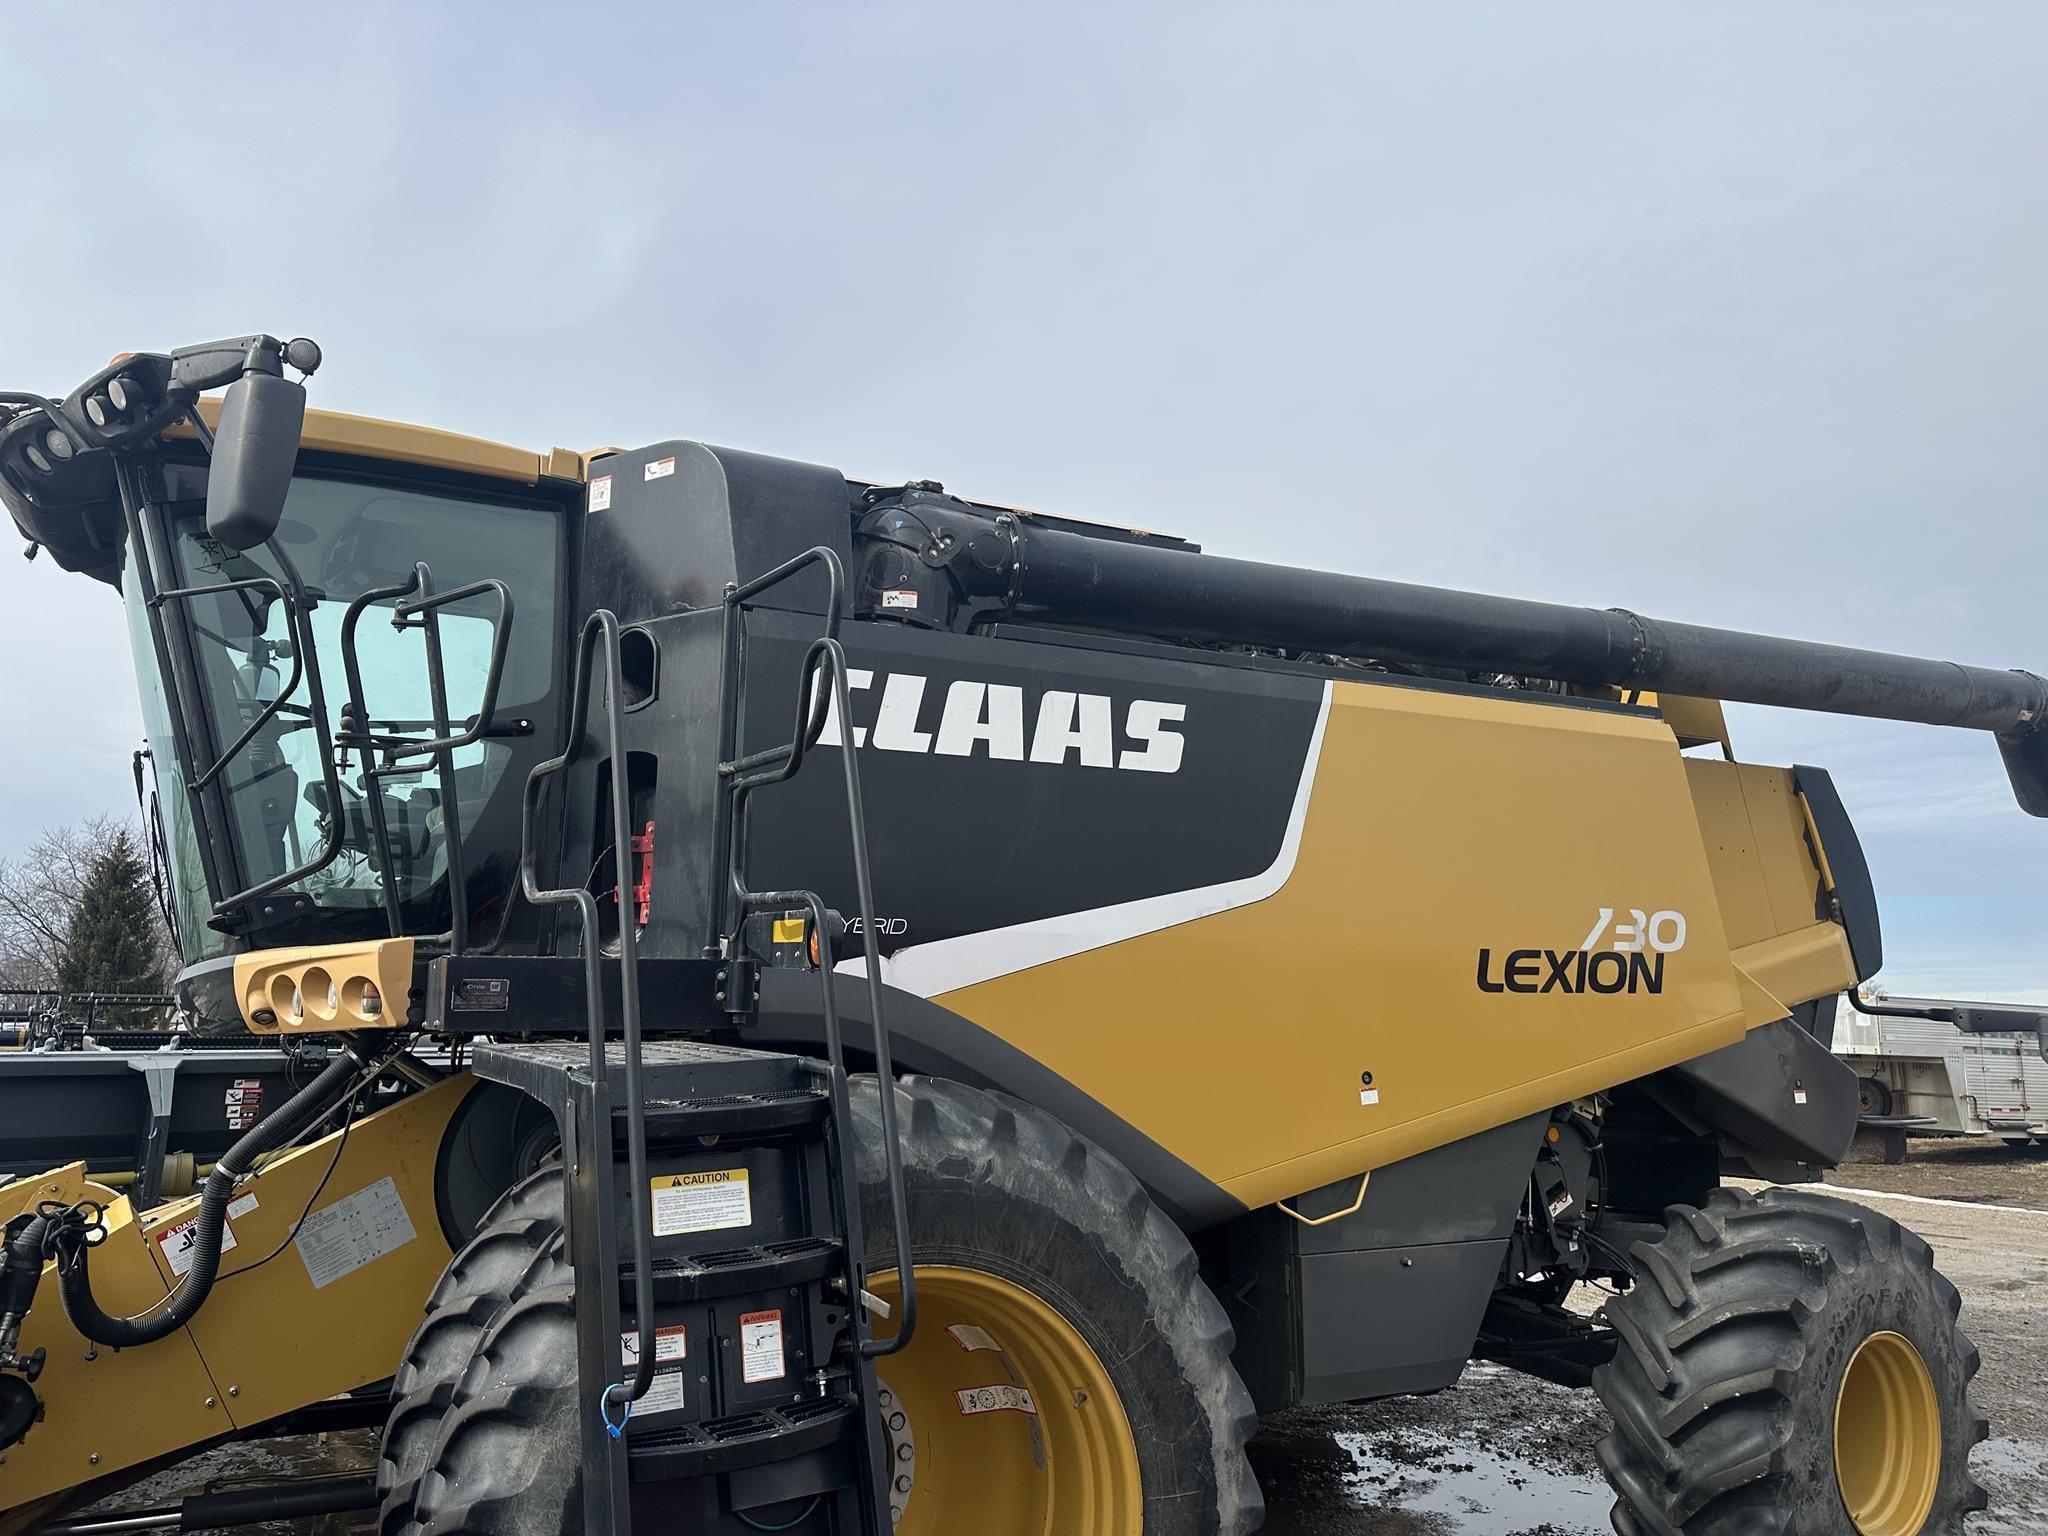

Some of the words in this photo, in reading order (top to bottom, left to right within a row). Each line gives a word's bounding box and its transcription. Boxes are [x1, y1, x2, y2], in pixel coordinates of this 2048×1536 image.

[806, 666, 1188, 774] CLAAS
[1580, 907, 1687, 952] 730
[1476, 948, 1665, 994] LEXION
[683, 1171, 731, 1186] CAUTION
